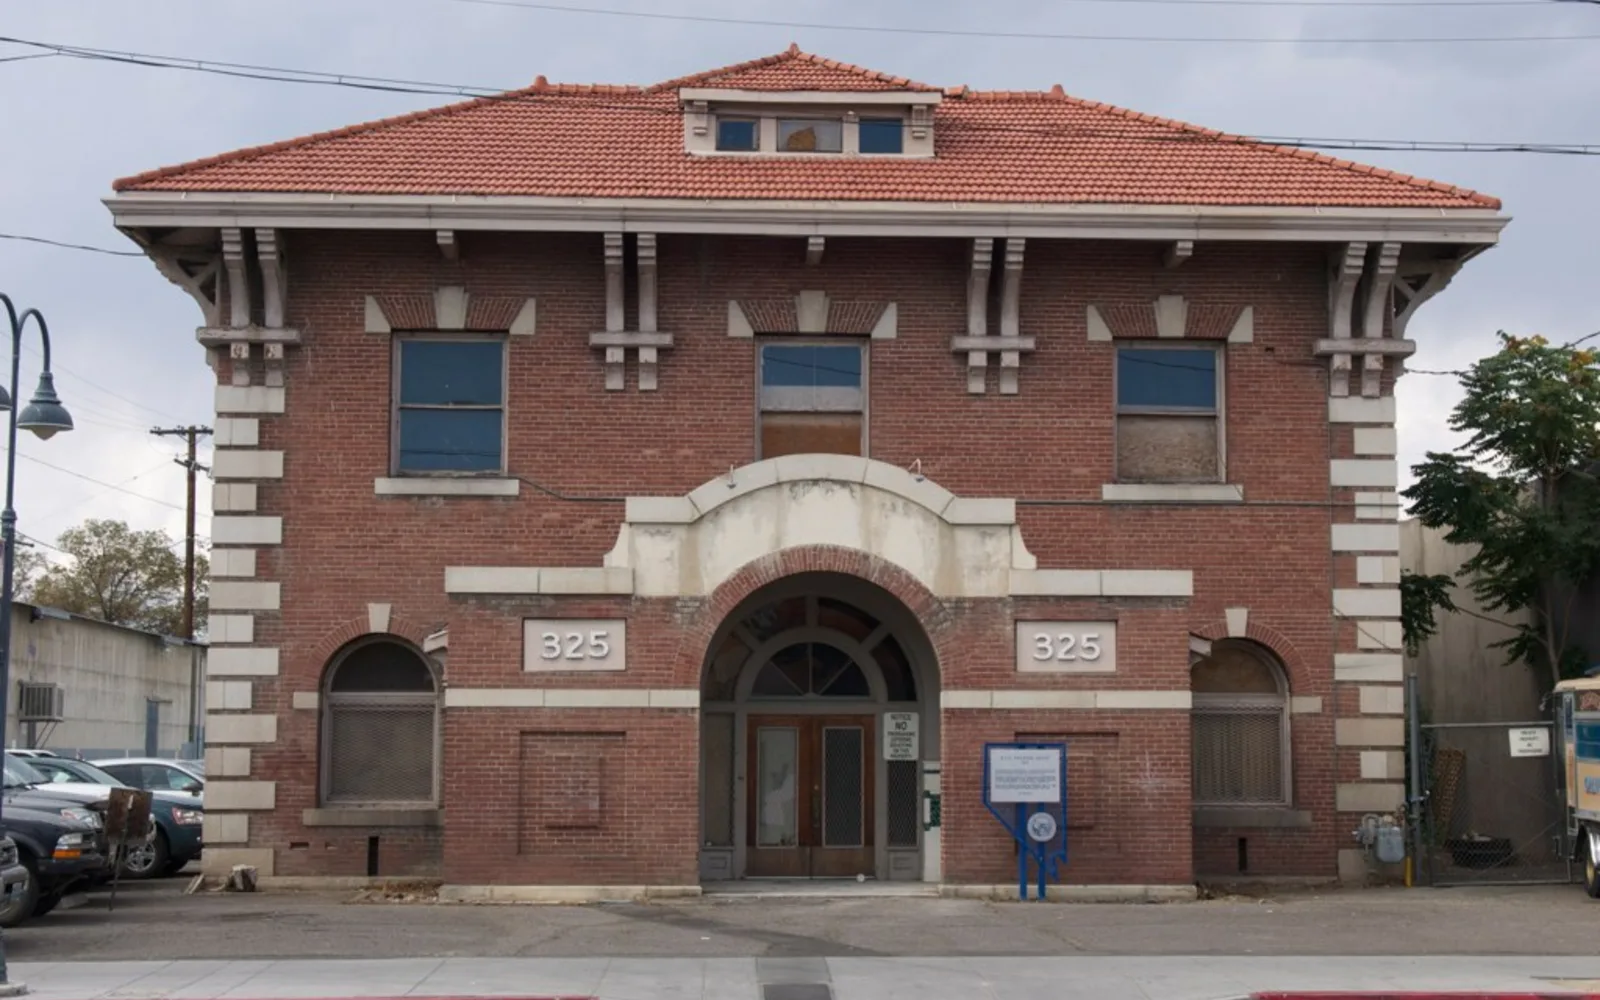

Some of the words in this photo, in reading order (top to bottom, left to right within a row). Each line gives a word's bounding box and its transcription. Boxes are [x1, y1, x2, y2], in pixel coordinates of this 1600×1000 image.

[541, 629, 610, 660] 325
[1032, 632, 1101, 661] 325
[895, 721, 908, 730] NO
